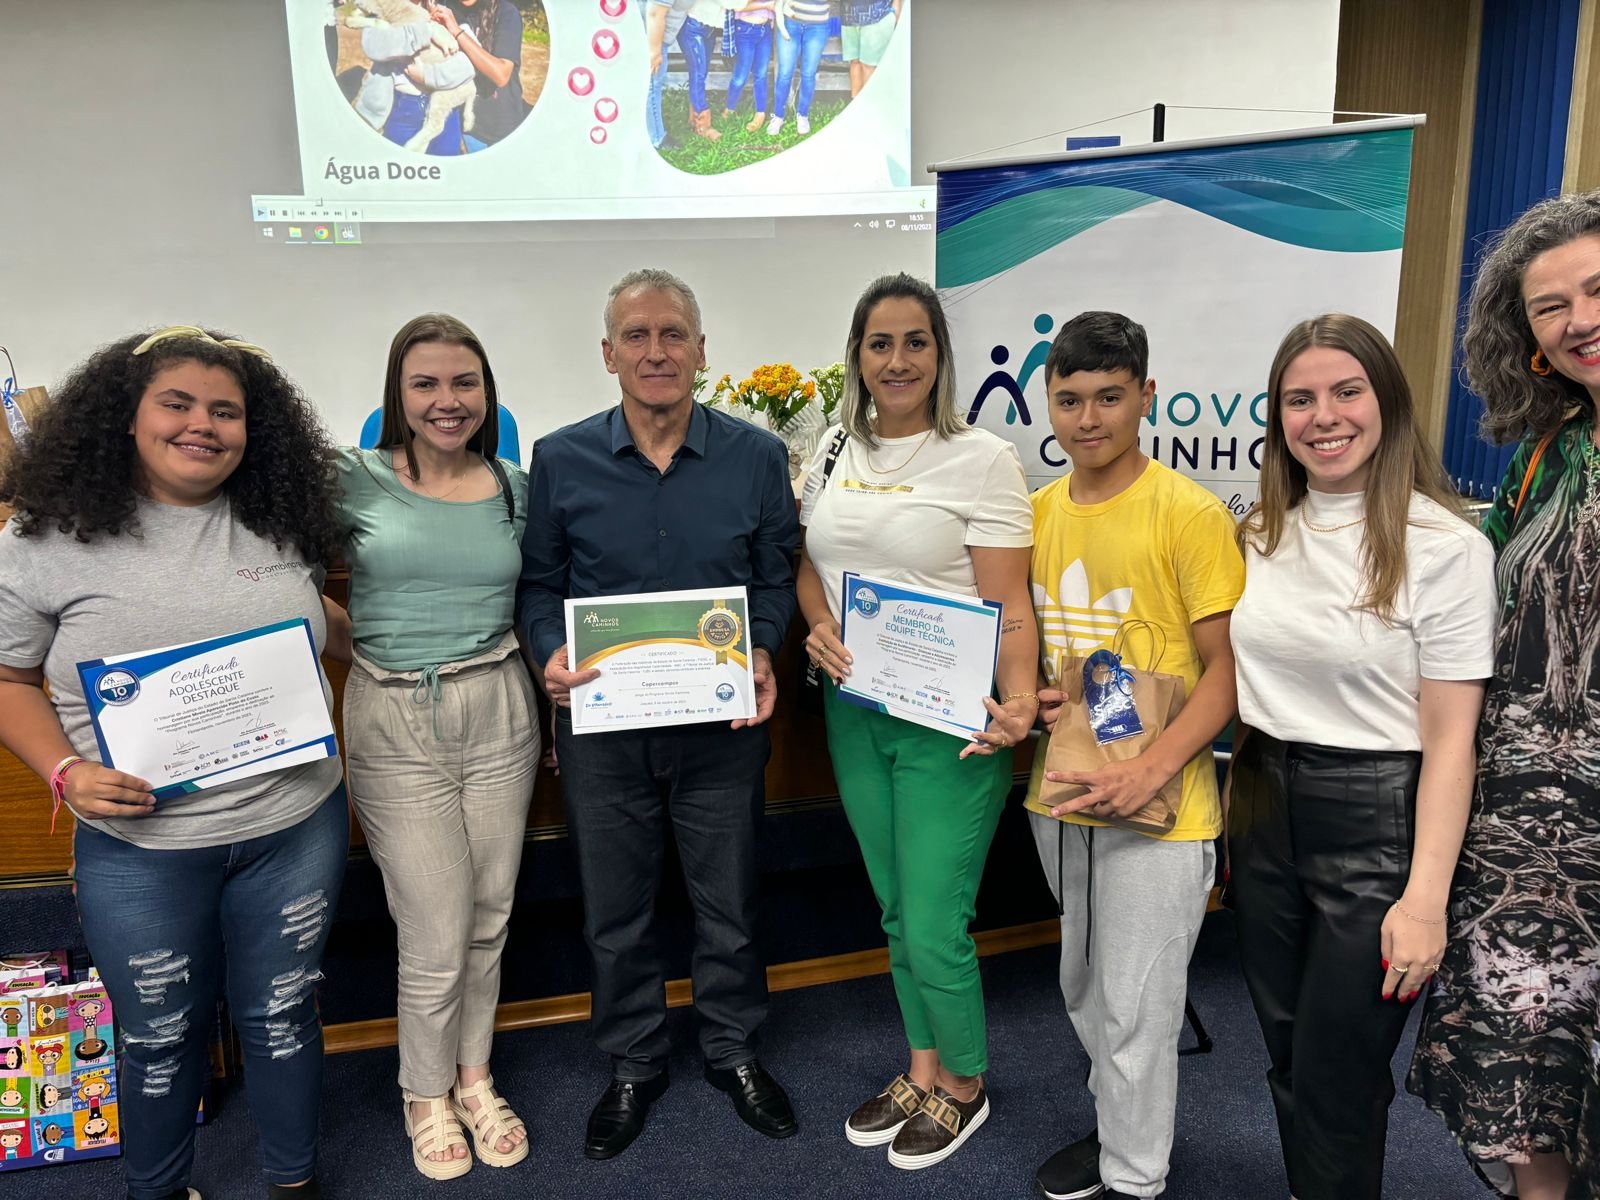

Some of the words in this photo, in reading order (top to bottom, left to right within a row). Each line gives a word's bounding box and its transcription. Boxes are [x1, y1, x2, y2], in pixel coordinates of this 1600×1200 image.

[324, 157, 380, 184] Água
[388, 161, 441, 180] Doce
[861, 600, 872, 611] 10
[896, 603, 944, 623] Certificado
[885, 622, 917, 637] EQUIPE
[918, 627, 956, 647] TÉCNICA
[892, 614, 931, 631] MEMBRO
[933, 624, 946, 635] DA
[170, 656, 241, 685] Certificado
[110, 686, 127, 699] 10
[168, 670, 246, 698] ADOLESCENTE
[182, 681, 241, 706] DESTAQUE
